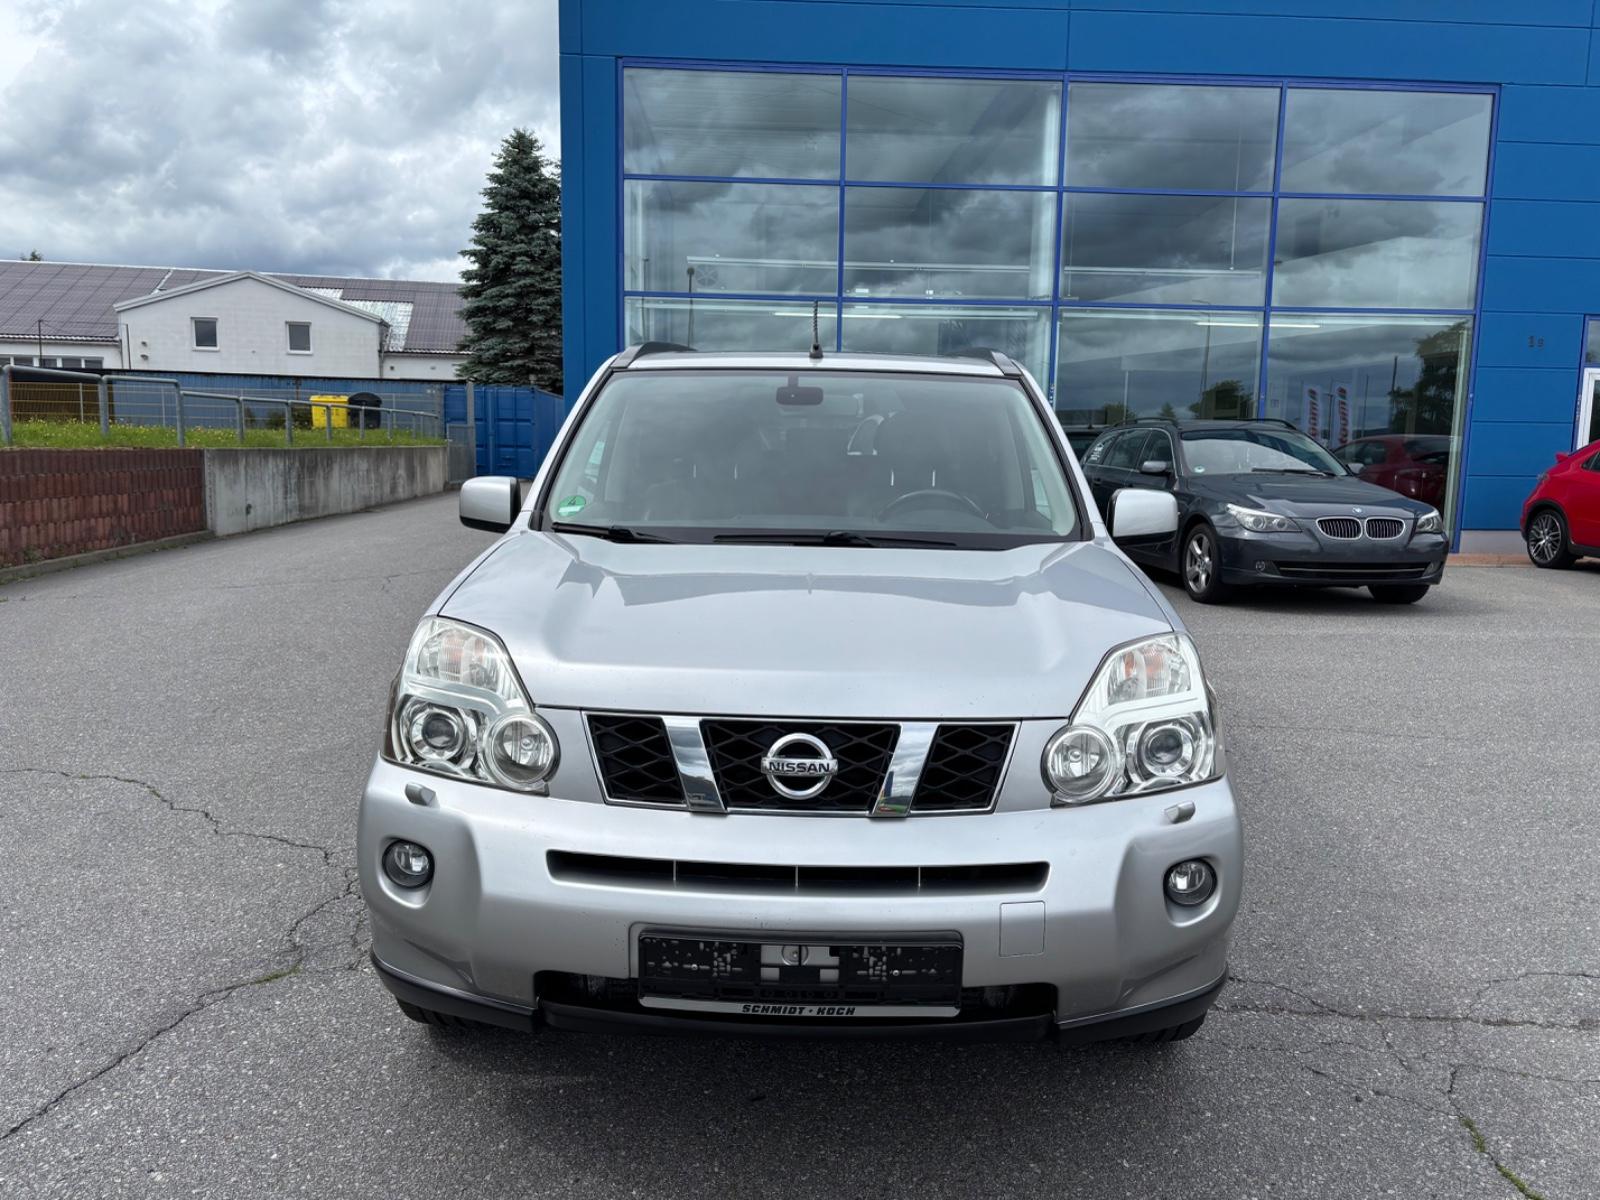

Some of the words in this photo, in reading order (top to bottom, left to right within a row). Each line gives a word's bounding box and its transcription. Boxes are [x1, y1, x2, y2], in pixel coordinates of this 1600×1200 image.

[769, 761, 830, 773] NISSAN
[742, 1004, 806, 1015] SCHMIDT
[816, 1006, 856, 1016] KOCH
